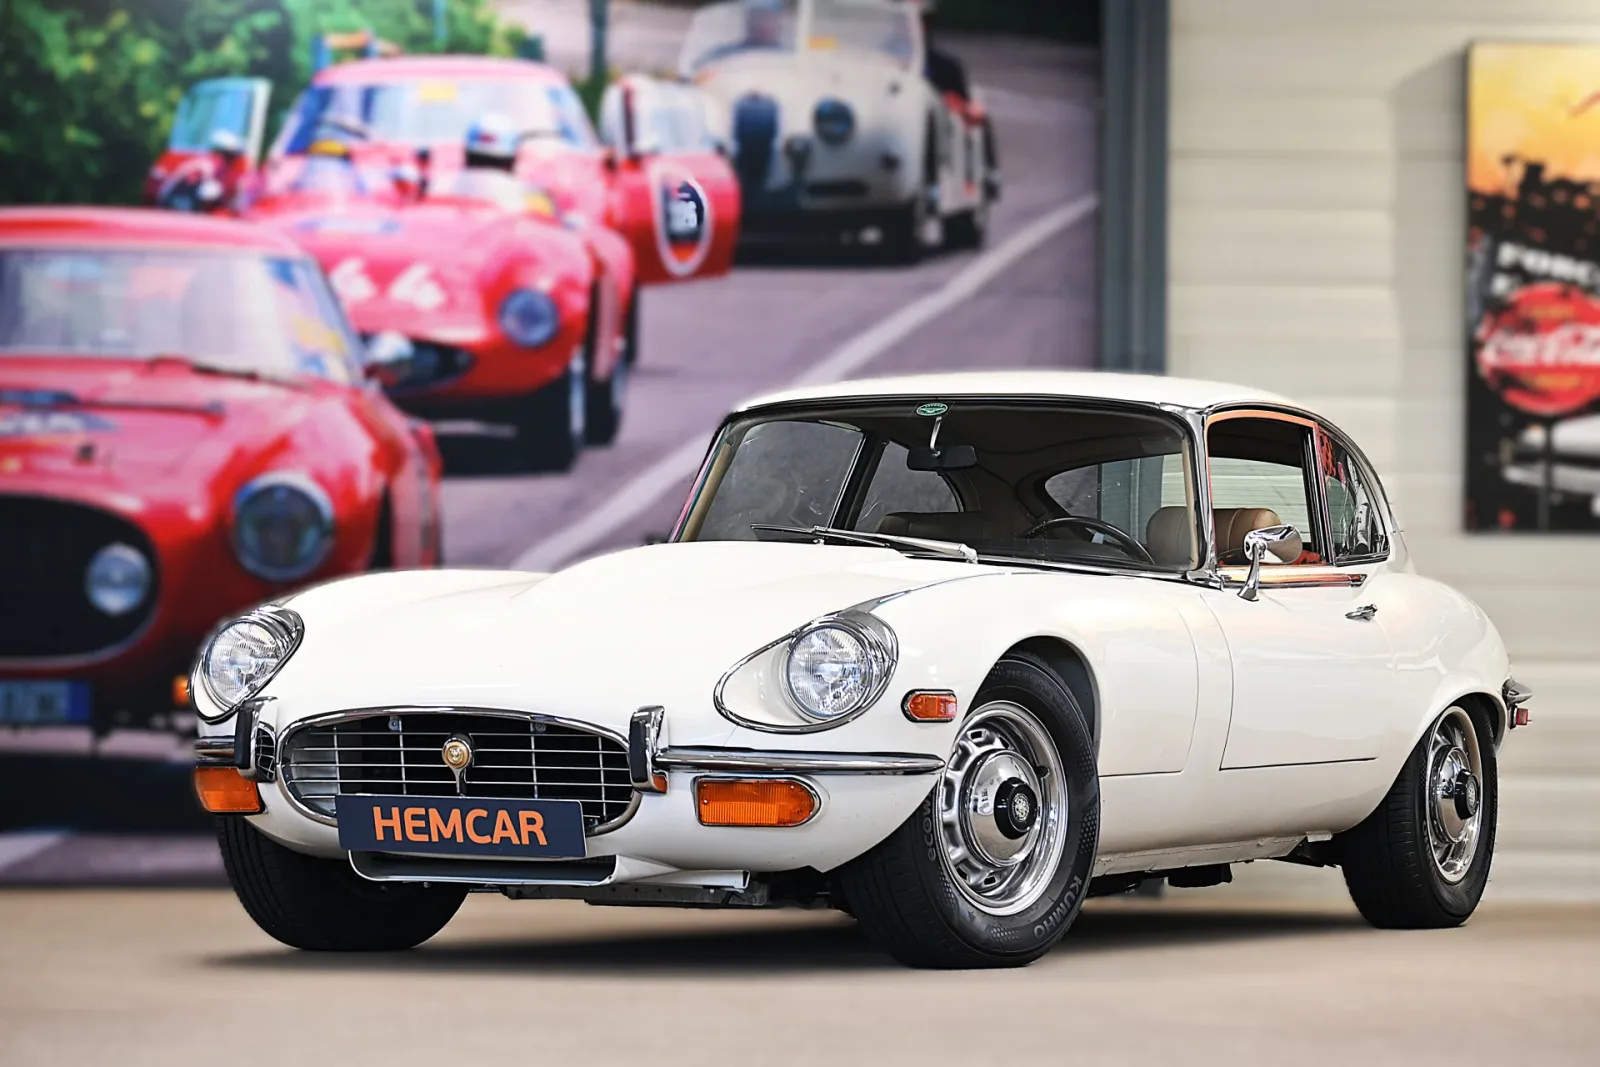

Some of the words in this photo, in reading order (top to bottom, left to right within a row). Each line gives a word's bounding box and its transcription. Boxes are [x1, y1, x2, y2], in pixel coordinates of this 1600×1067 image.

[372, 806, 548, 846] HEMCAR
[923, 795, 936, 862] ecow
[1033, 875, 1083, 940] KUMHO
